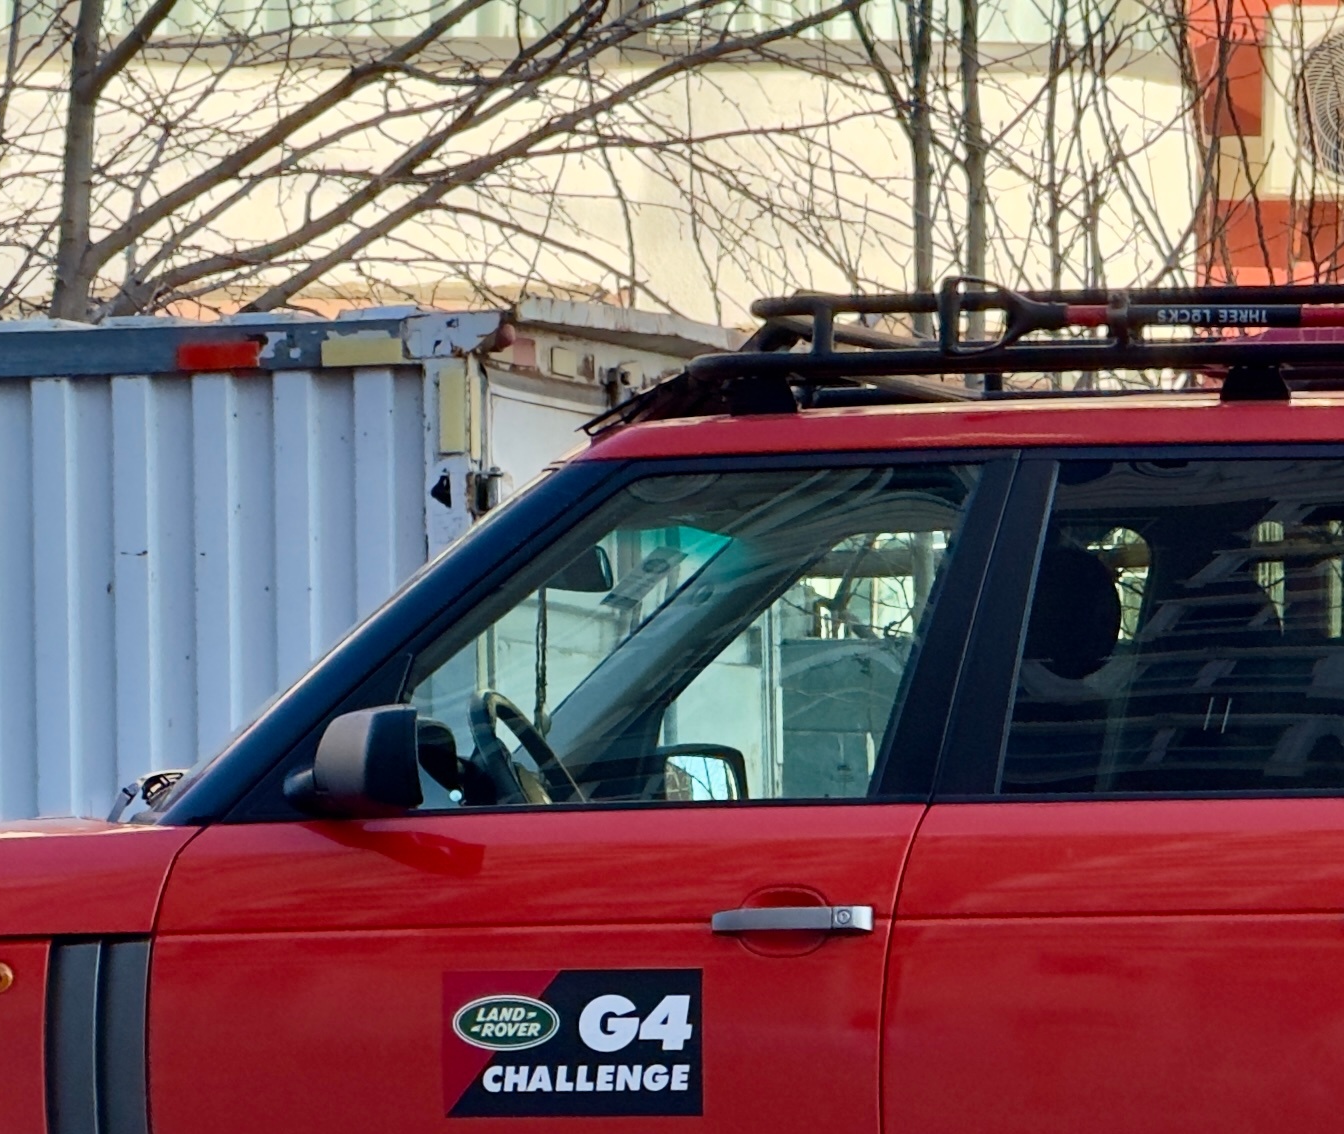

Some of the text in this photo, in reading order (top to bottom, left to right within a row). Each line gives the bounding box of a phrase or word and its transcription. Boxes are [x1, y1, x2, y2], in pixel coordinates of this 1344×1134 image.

[1218, 308, 1269, 324] THREE
[476, 1006, 527, 1023] LAND
[480, 1022, 542, 1038] ROVER
[578, 994, 693, 1053] G4
[482, 1063, 691, 1093] CHALLENGE
